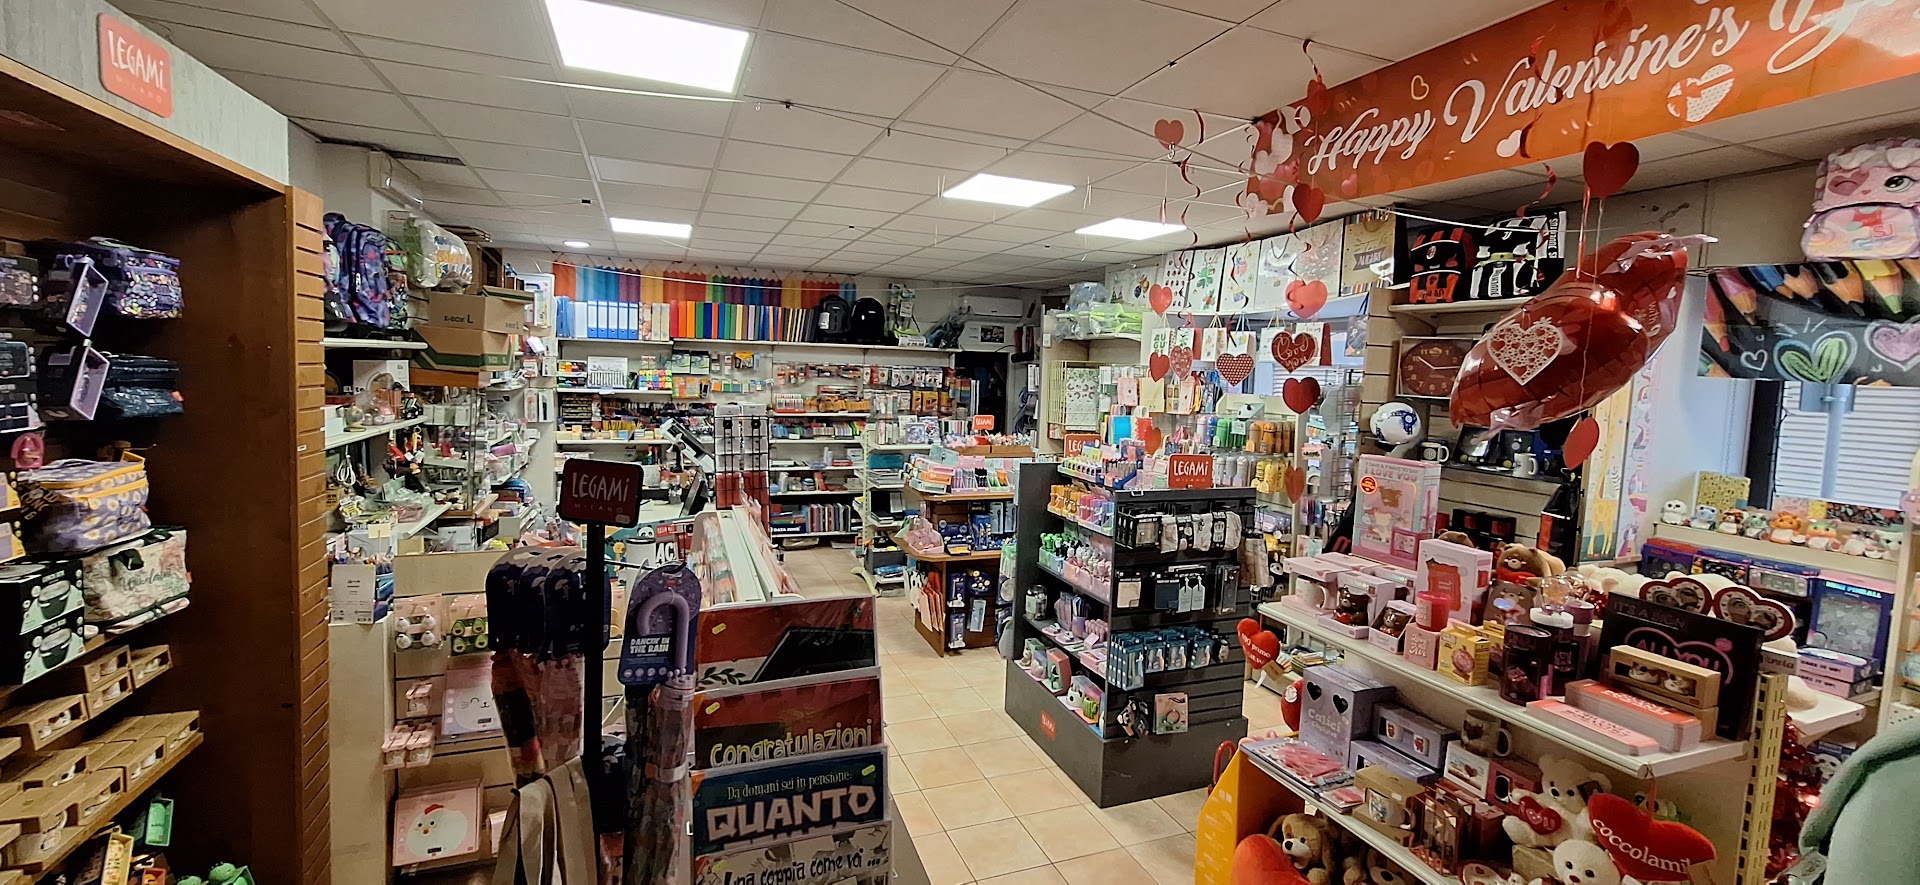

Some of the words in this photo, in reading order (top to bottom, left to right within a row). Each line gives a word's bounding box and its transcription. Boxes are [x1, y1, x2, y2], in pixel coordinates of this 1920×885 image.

[1305, 107, 1437, 175] Happy
[1443, 6, 1750, 143] Valentine's
[1873, 223, 1893, 238] SJ
[467, 314, 473, 323] L
[1370, 468, 1394, 479] LOVE
[1396, 472, 1417, 482] YOU
[630, 645, 647, 654] THE
[647, 644, 669, 653] RAIN
[710, 718, 872, 768] Congratulazioni
[727, 786, 740, 800] Da
[743, 780, 779, 797] domani
[781, 777, 795, 791] sei
[796, 776, 806, 788] in
[706, 784, 877, 842] QUANTO
[760, 857, 806, 885] coppia
[809, 854, 843, 877] come
